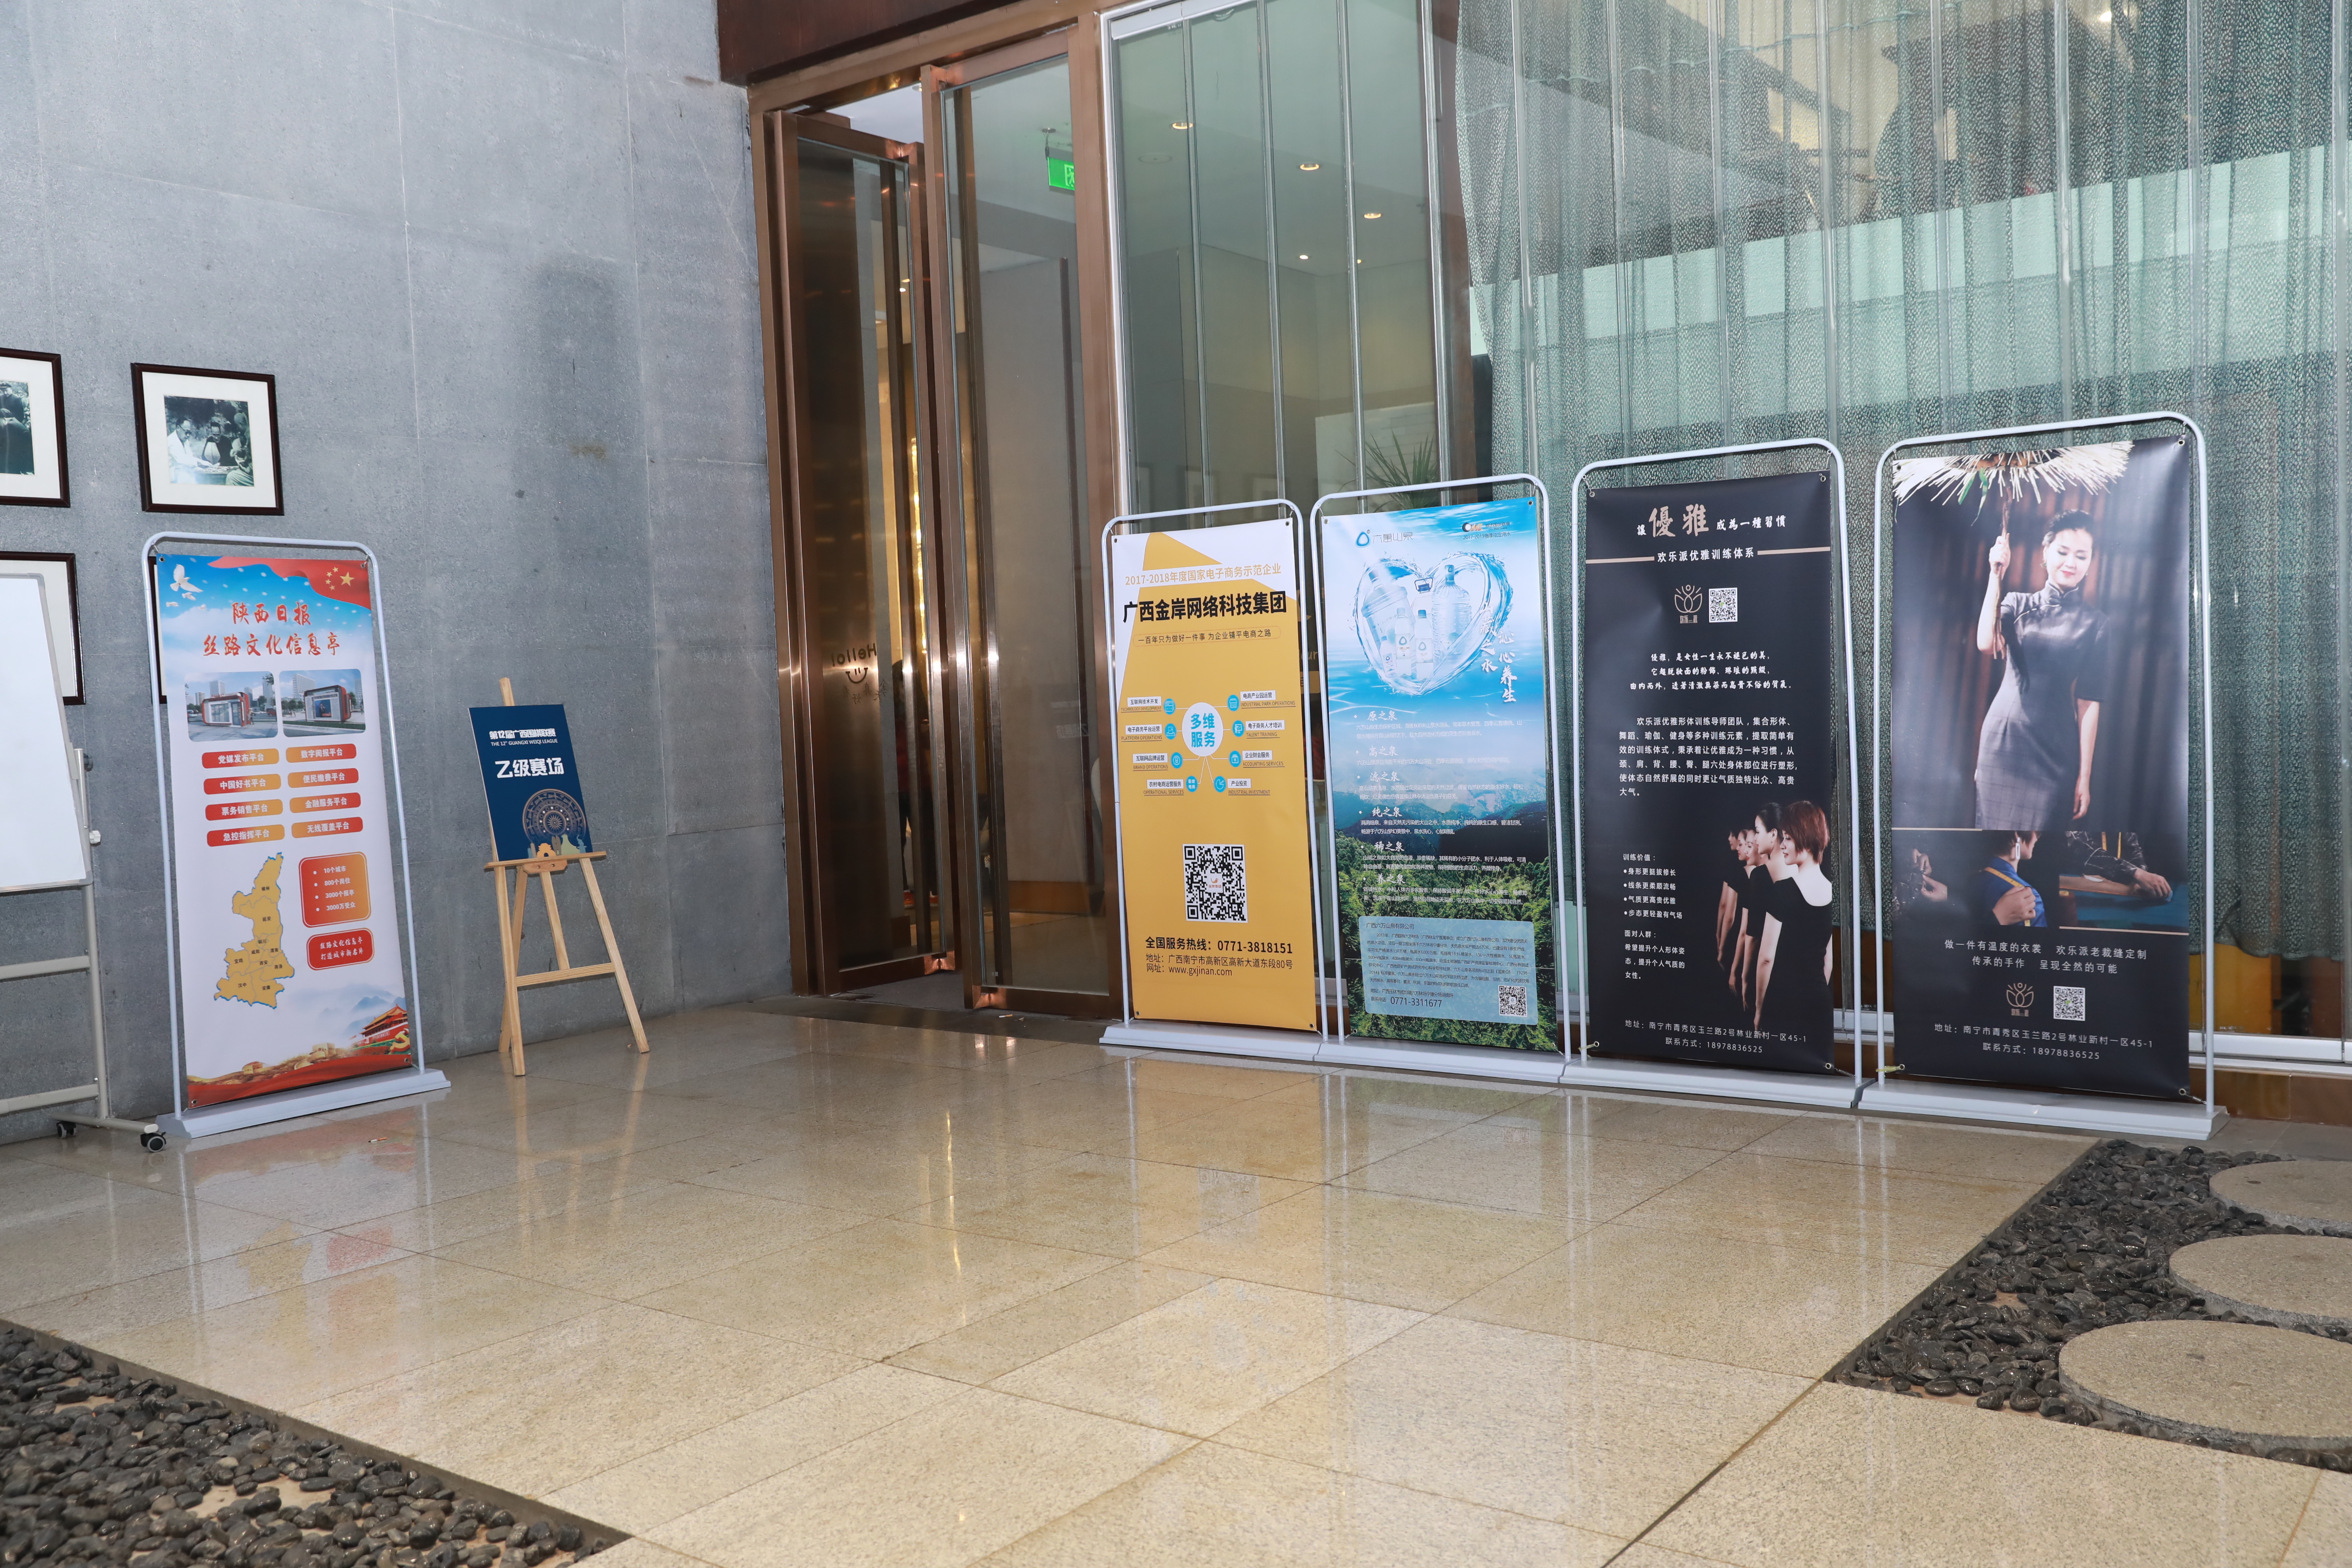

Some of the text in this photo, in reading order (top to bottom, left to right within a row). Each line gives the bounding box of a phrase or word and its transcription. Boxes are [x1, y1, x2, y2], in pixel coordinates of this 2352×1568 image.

[1636, 503, 1786, 537] 讓 優雅 成為一種習慣
[1657, 547, 1755, 563] 欢乐派优雅训练体系
[1125, 563, 1282, 586] 2017-2018年度国家电子商务示范企业
[1123, 591, 1287, 623] 广西金岸网络科技集团
[232, 602, 312, 626] 陕西日报
[1138, 628, 1271, 644] 一百年只为做好一件事 为企业铺平电商之路
[203, 632, 340, 656] 丝路文化信息亭
[1190, 713, 1215, 729] 多维
[1367, 710, 1397, 721] 原之泉
[1636, 717, 1791, 726] 欢乐派优雅形体训练导师团队，集合形体、
[489, 728, 556, 740] 第12届广西围棋联赛
[1191, 731, 1216, 748] 服务
[1619, 731, 1795, 740] 舞蹈、瑜伽、健身等多种训练元素，提取简单有
[301, 748, 342, 758] 数字阅报平台
[1369, 746, 1398, 757] 高之泉
[1619, 745, 1795, 756] 效的训练体式，秉承着让优雅成为一种习惯，从
[218, 753, 264, 764] 党媒发布平台
[495, 758, 564, 778] 乙级赛场
[303, 772, 345, 783] 便民缴费平台
[1370, 771, 1400, 782] 滤之泉
[1619, 773, 1795, 785] 使体态自然舒展的同时更让气质独特出众、高贵
[220, 778, 266, 789] 中国好书平台
[1619, 788, 1640, 797] 大气。
[305, 797, 347, 808] 金融服务平台
[221, 803, 268, 816] 票务销售平台
[1372, 806, 1402, 817] 纯之泉
[307, 821, 349, 834] 无线覆盖平台
[223, 829, 270, 841] 急控指挥平台
[1374, 840, 1405, 852] 稀之泉
[1623, 853, 1655, 861] 训练价值：
[1628, 867, 1676, 876] 身形更挺拔修长
[325, 877, 350, 886] 800个岗位
[1376, 873, 1406, 885] 养之泉
[1628, 881, 1676, 890] 线条更柔顺流畅
[326, 889, 355, 898] 3000个报亭
[326, 901, 356, 911] 3000万受众
[1628, 896, 1676, 905] 气质更高贵优雅
[1629, 909, 1682, 919] 步态更轻盈有气场
[320, 936, 363, 949] 丝路文化信息亭
[1145, 936, 1292, 954] 全国服务热线：0771-3818151
[321, 949, 364, 960] 打造城市新名片
[1625, 944, 1685, 955] 希望提升个人形体姿
[1944, 939, 2147, 959] 做一件有温度的衣裳 欢乐派老裁缝定制
[1145, 953, 1293, 969] 地址：广西南宁市高新区高新大道东段80号
[1625, 957, 1685, 968] 态，提升个人气质的
[1972, 956, 2118, 974] 传承的手作 呈现全然的可能
[1146, 964, 1232, 976] 网址：www.gxjinan.com
[1390, 996, 1442, 1007] 0771-3311677
[1625, 1020, 1806, 1042] 地址：南宁市青秀区玉兰路2号林业新村一区45-1
[1934, 1024, 2152, 1047] 地址：南宁市青秀区玉兰路2号林业新村一区45-1
[1665, 1037, 1763, 1053] 联系方式：18978836525
[1983, 1042, 2100, 1060] 联系方式：18978836525
